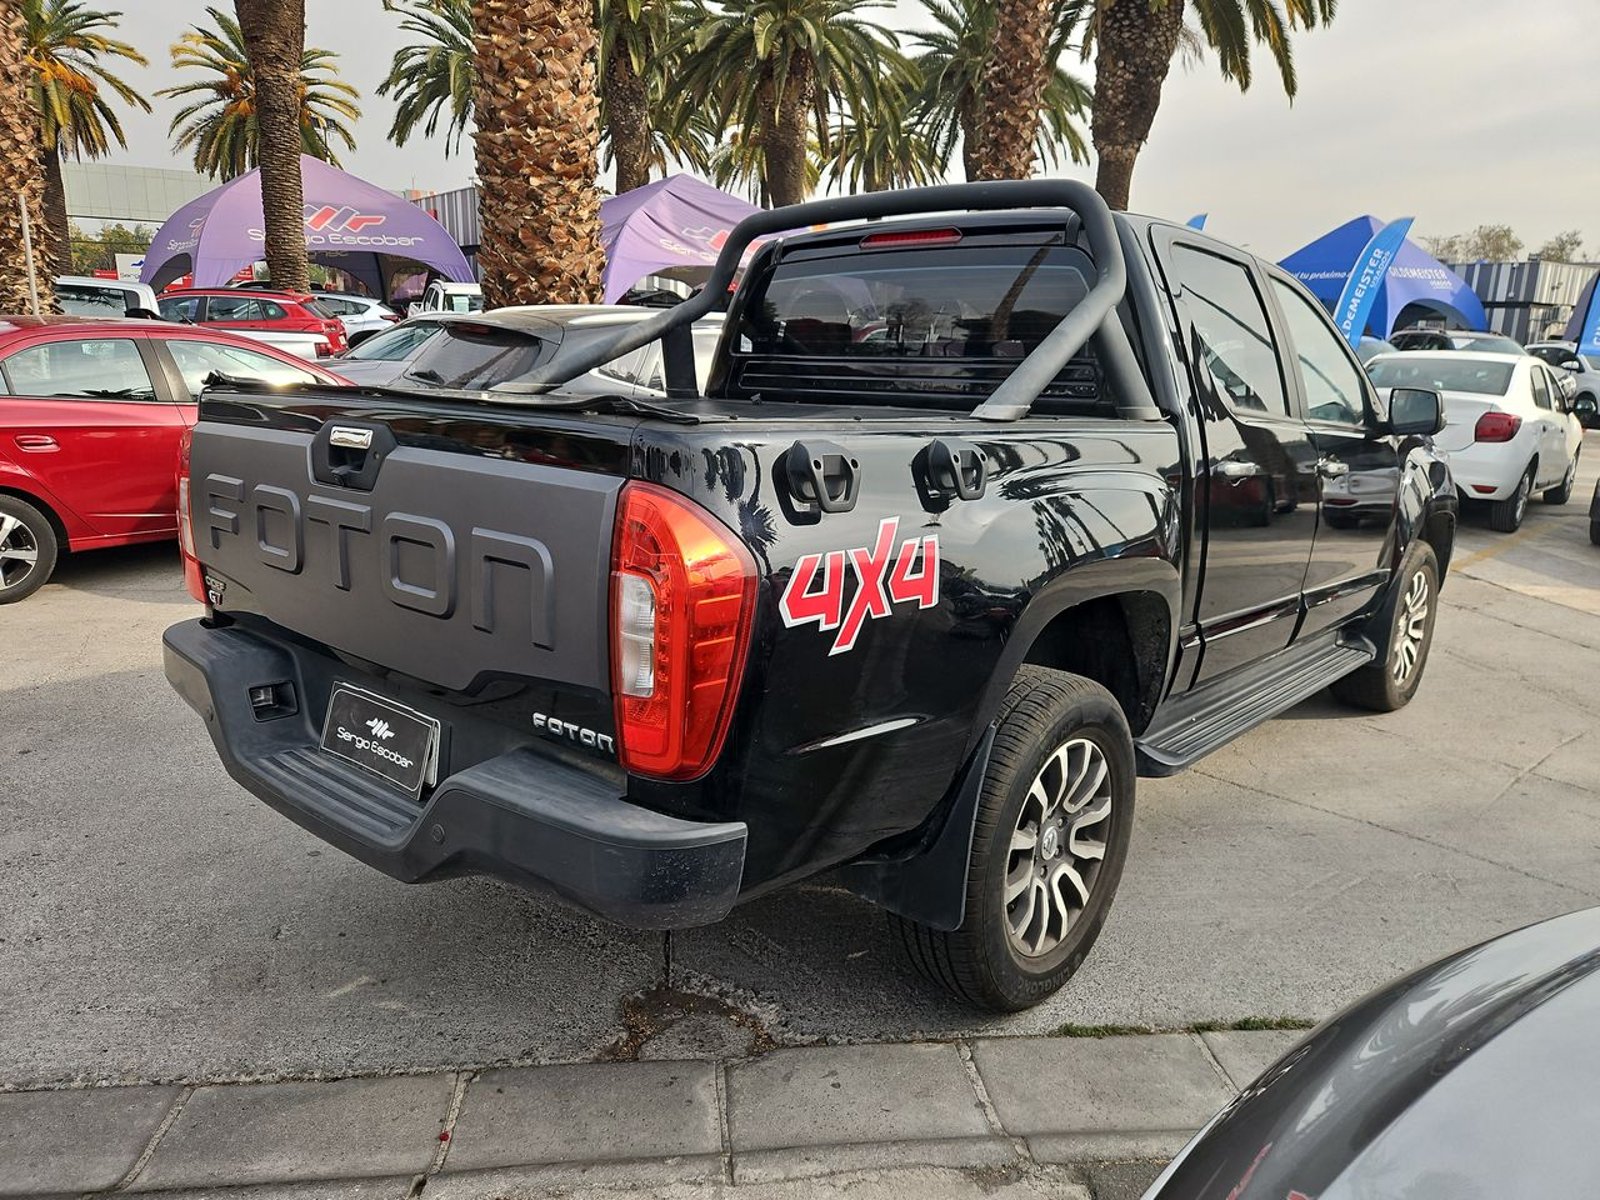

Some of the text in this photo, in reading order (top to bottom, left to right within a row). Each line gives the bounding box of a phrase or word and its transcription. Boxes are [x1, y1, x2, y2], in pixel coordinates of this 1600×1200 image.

[328, 232, 425, 247] Escobar
[205, 472, 556, 652] FOTON
[532, 711, 615, 754] FOTON
[370, 740, 414, 768] Escobar
